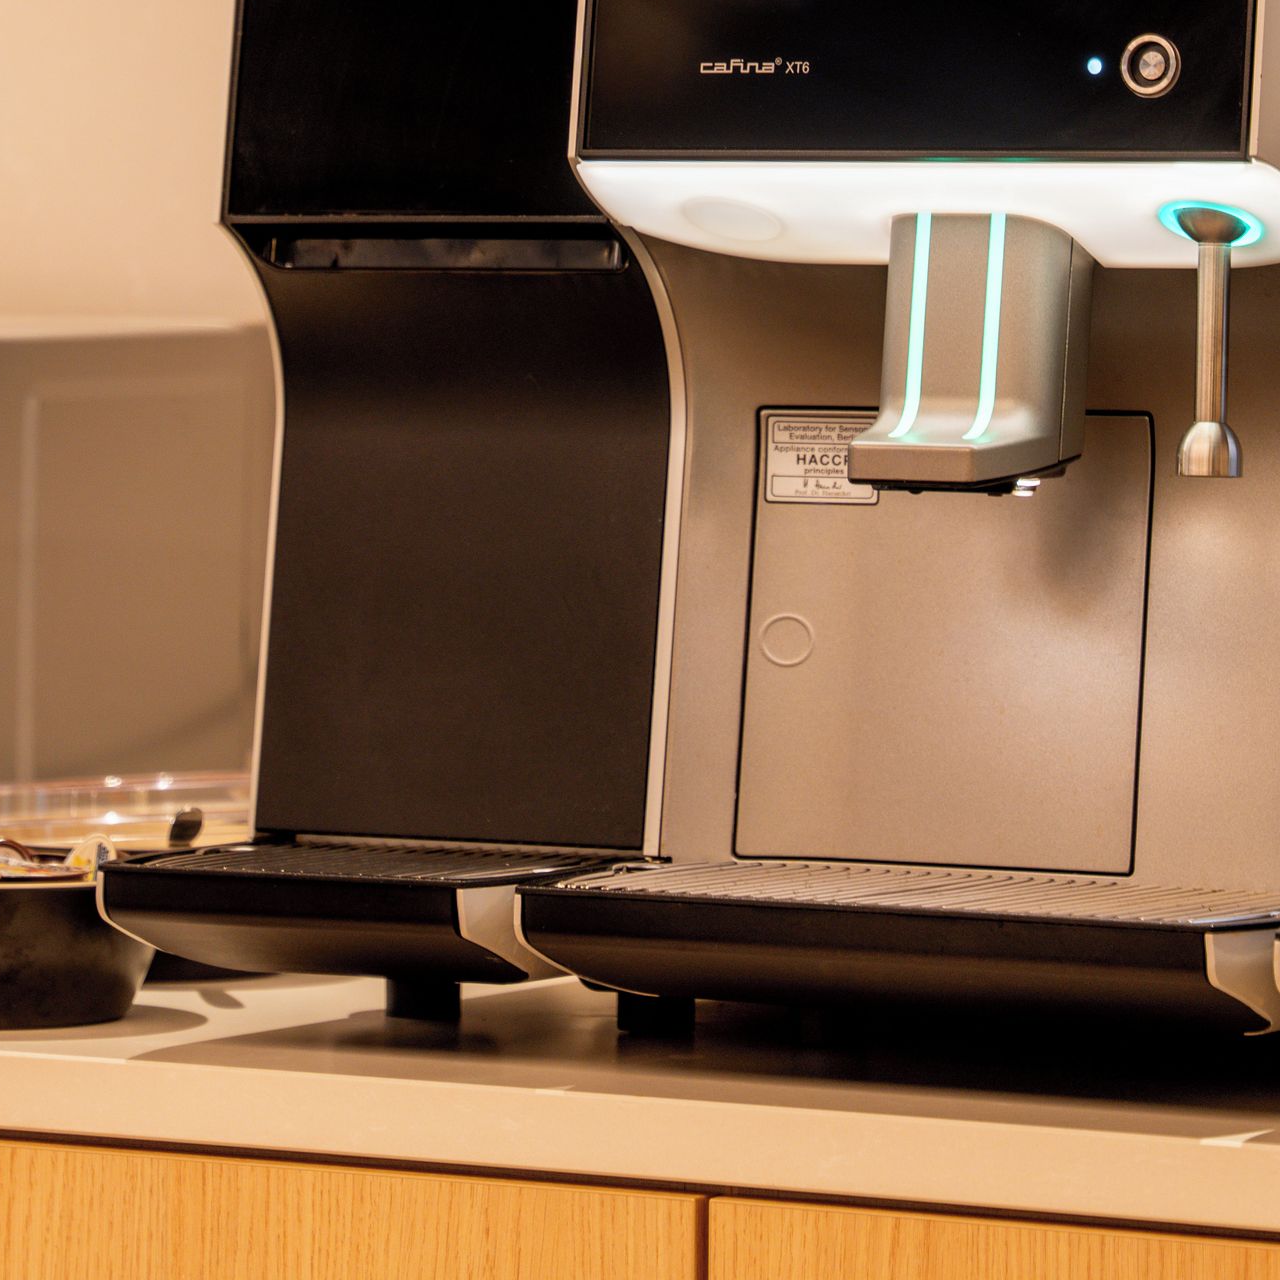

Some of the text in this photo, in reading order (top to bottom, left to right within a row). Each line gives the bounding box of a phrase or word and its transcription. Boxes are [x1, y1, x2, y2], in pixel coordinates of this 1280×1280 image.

[785, 61, 810, 74] XT6
[777, 424, 870, 433] Laboratory for Sensor
[837, 433, 855, 441] Berl
[774, 445, 815, 453] Appliance
[804, 467, 844, 476] principles
